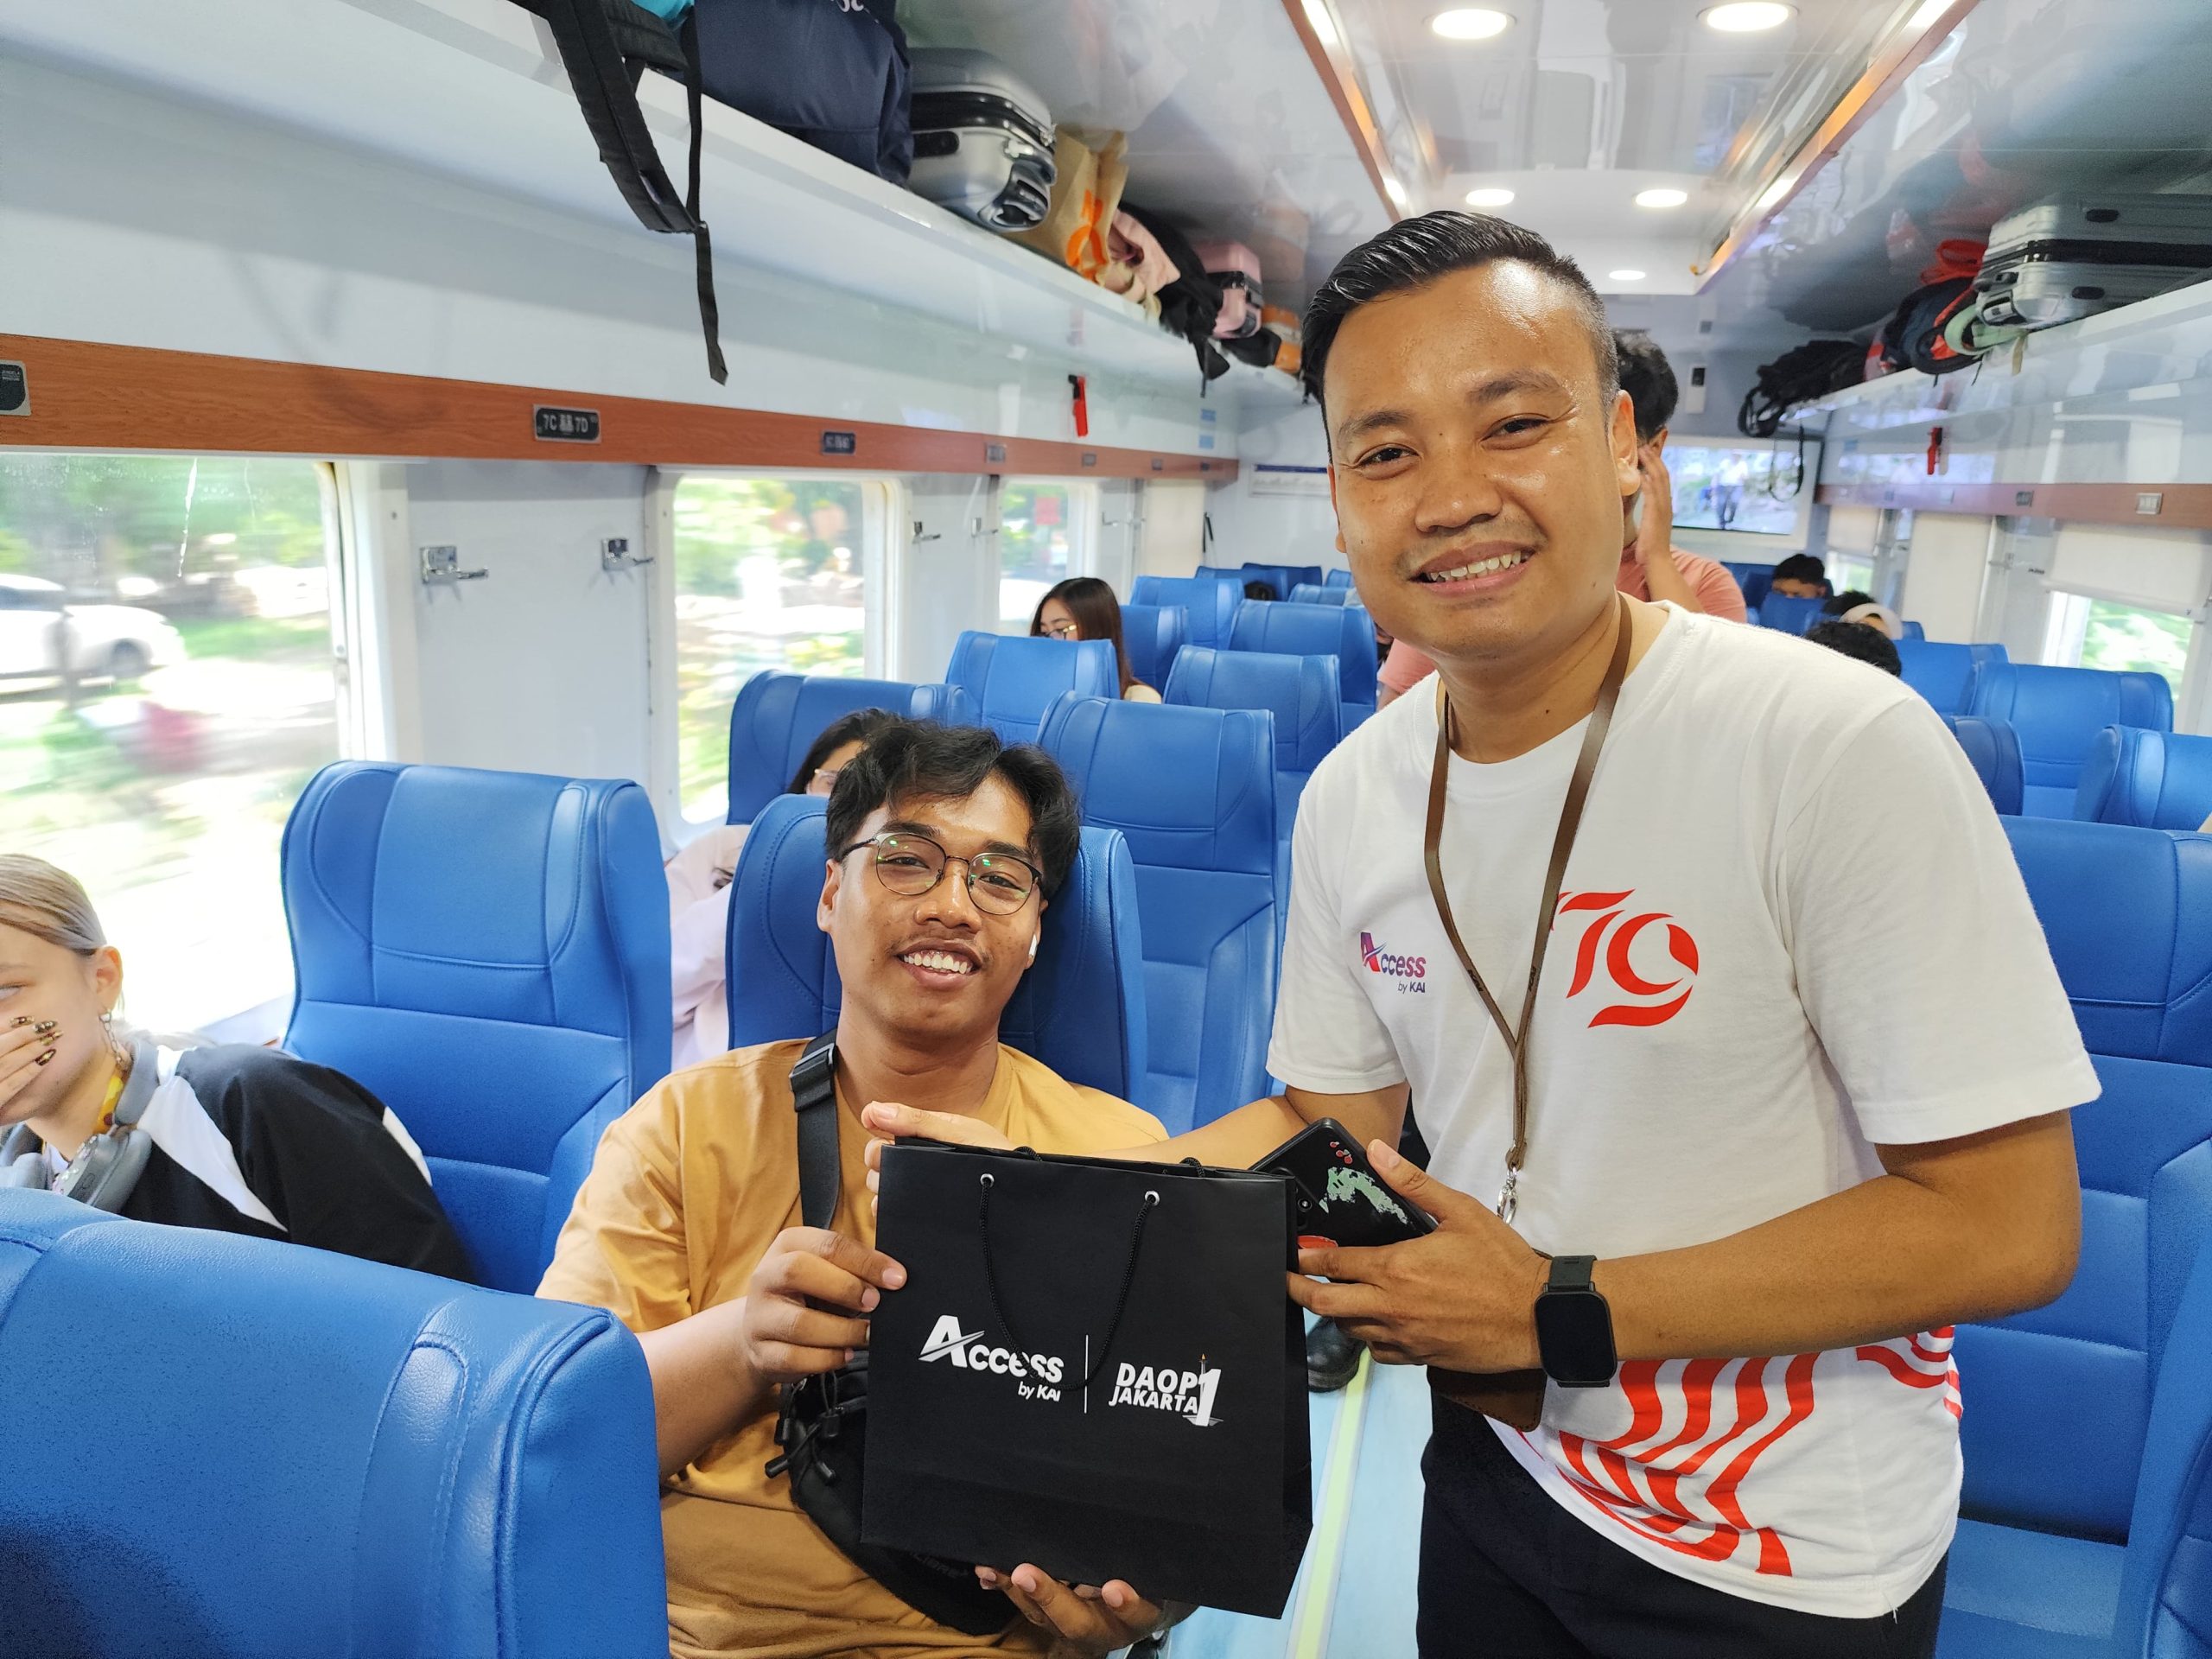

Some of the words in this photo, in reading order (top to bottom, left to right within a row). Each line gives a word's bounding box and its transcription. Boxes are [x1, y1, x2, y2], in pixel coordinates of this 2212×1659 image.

[543, 414, 557, 431] 7C
[575, 416, 588, 433] 7D
[1360, 931, 1427, 978] Access
[1397, 981, 1408, 995] by
[1409, 981, 1426, 994] KAI
[918, 1314, 1065, 1383] Access
[1018, 1381, 1035, 1400] by
[1036, 1383, 1061, 1402] KAI
[1116, 1362, 1198, 1395] DAOP
[1108, 1385, 1198, 1414] JAKARTA
